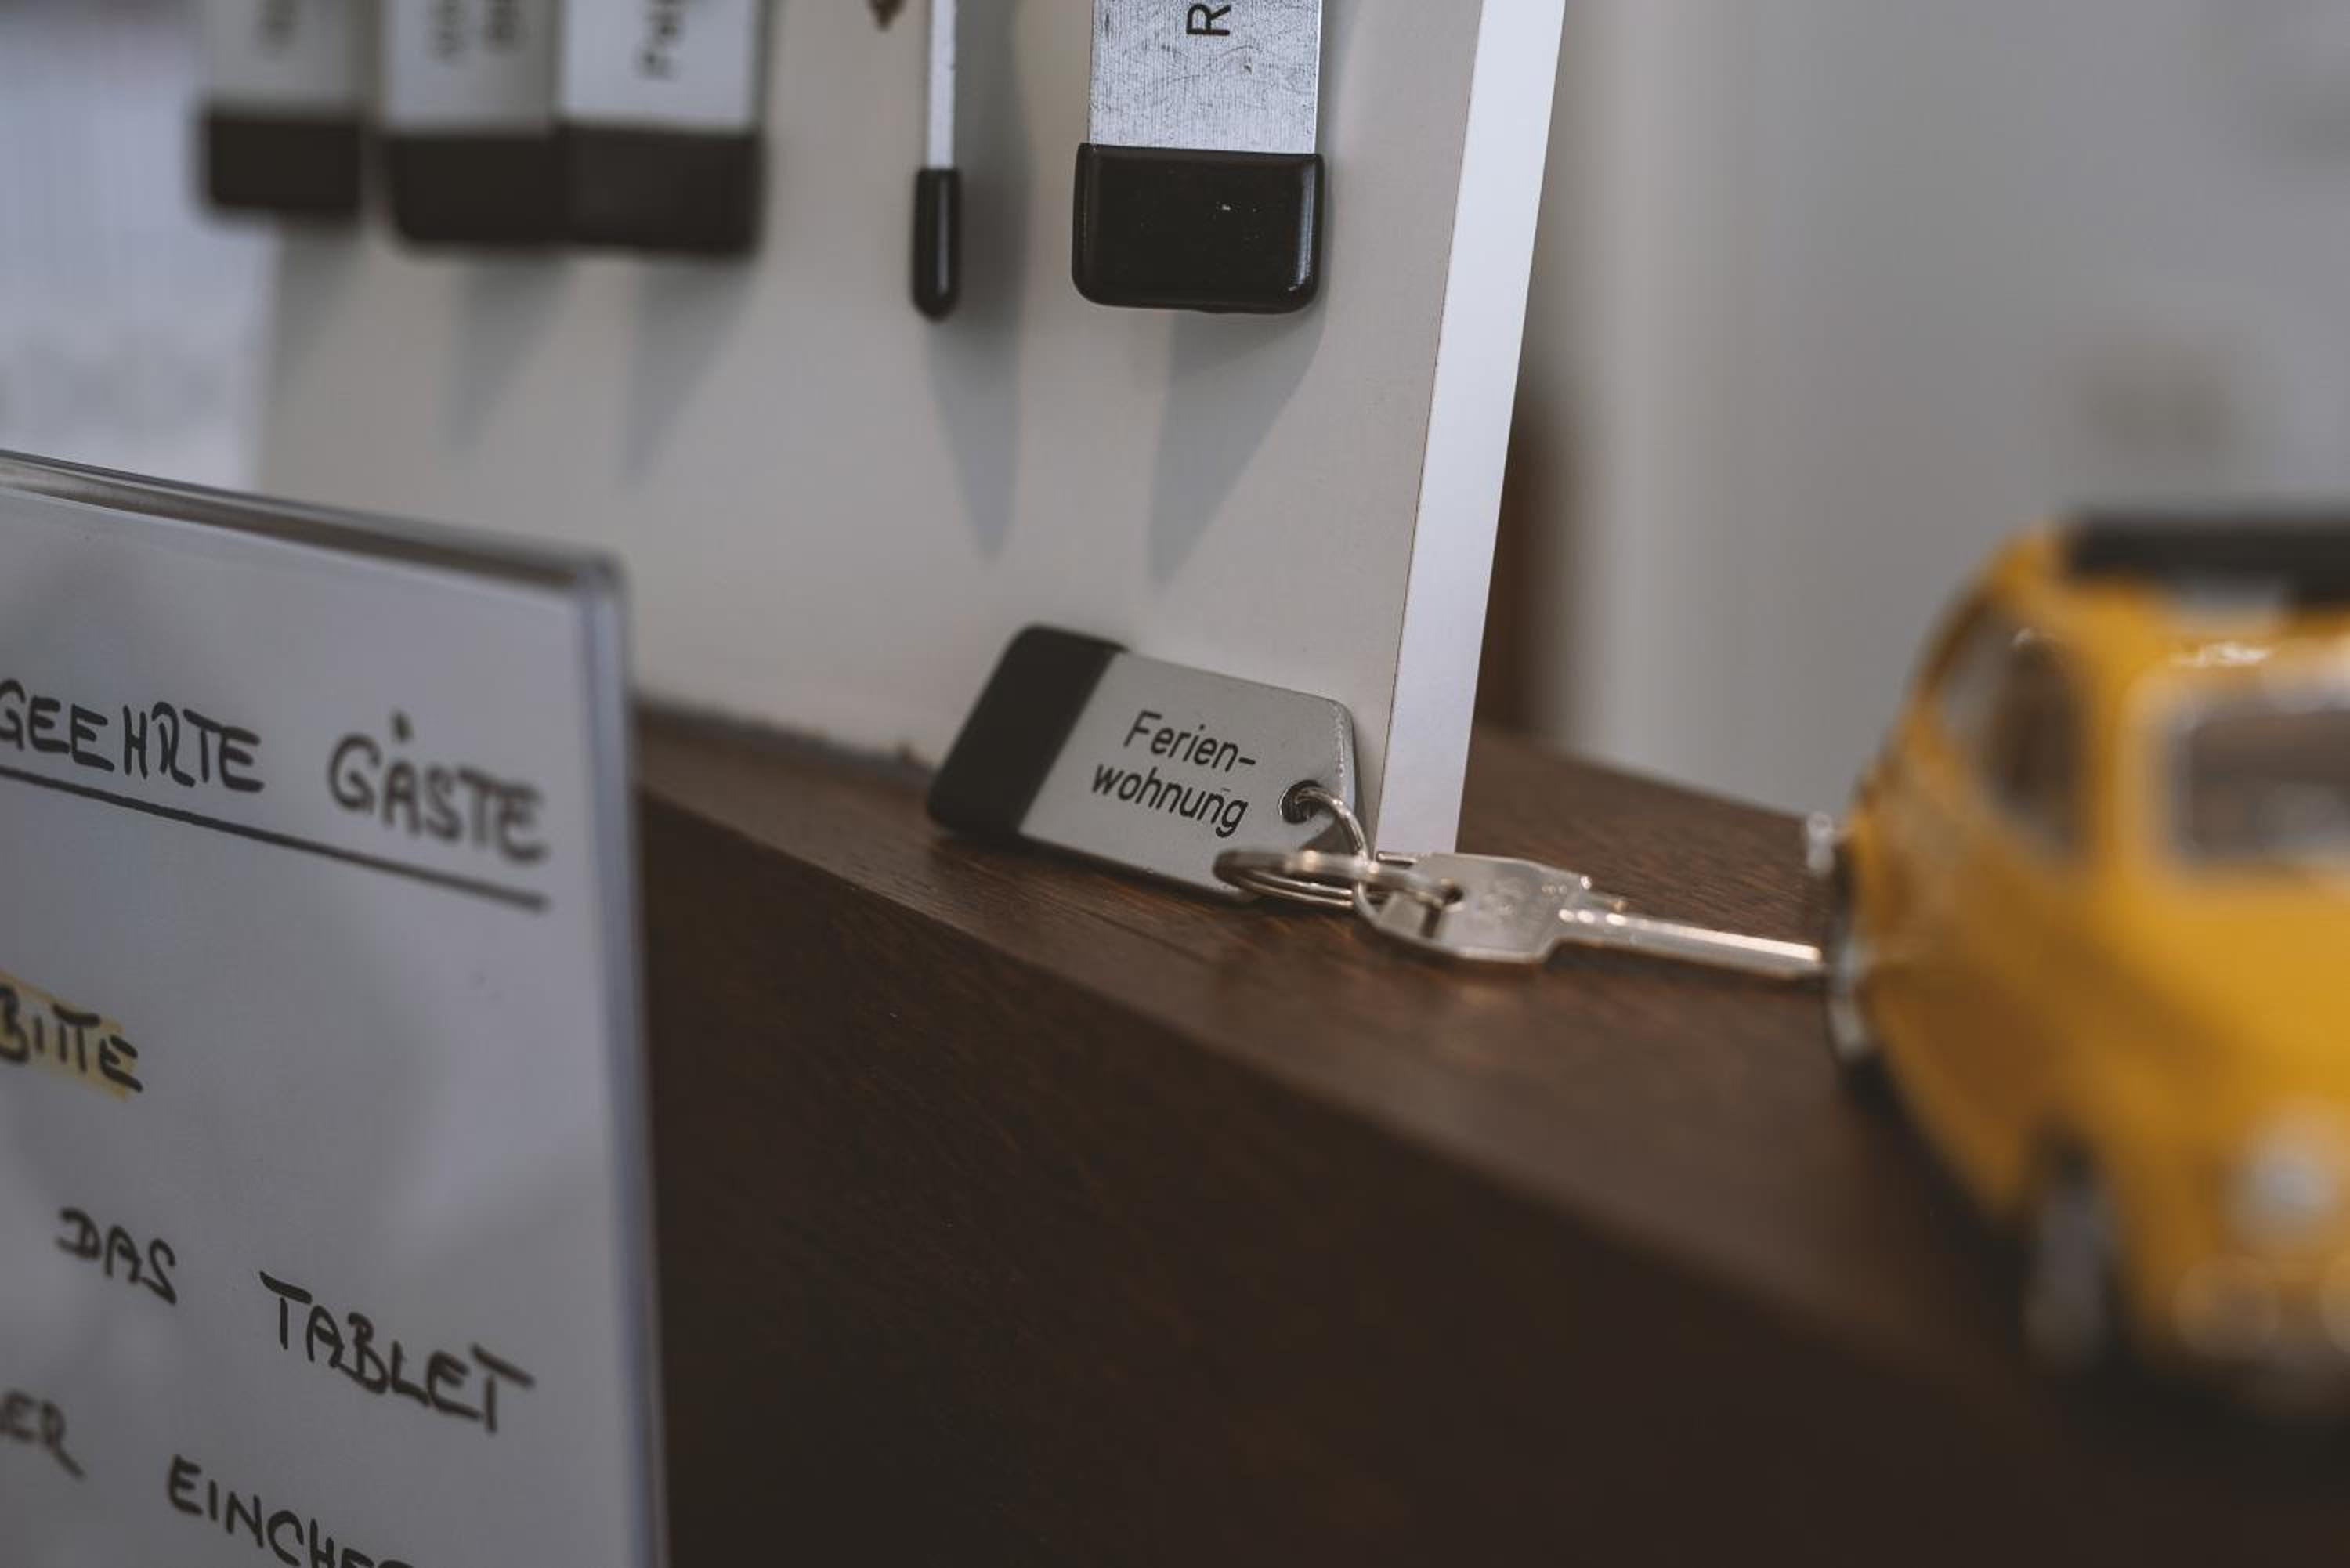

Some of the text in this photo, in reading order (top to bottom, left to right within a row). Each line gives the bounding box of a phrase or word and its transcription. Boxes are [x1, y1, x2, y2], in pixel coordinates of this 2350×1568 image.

[0, 679, 264, 793] GEEHRTE
[1123, 709, 1256, 772] Ferien-
[1092, 764, 1249, 838] wohnung
[57, 1206, 536, 1434] DAS TABLET
